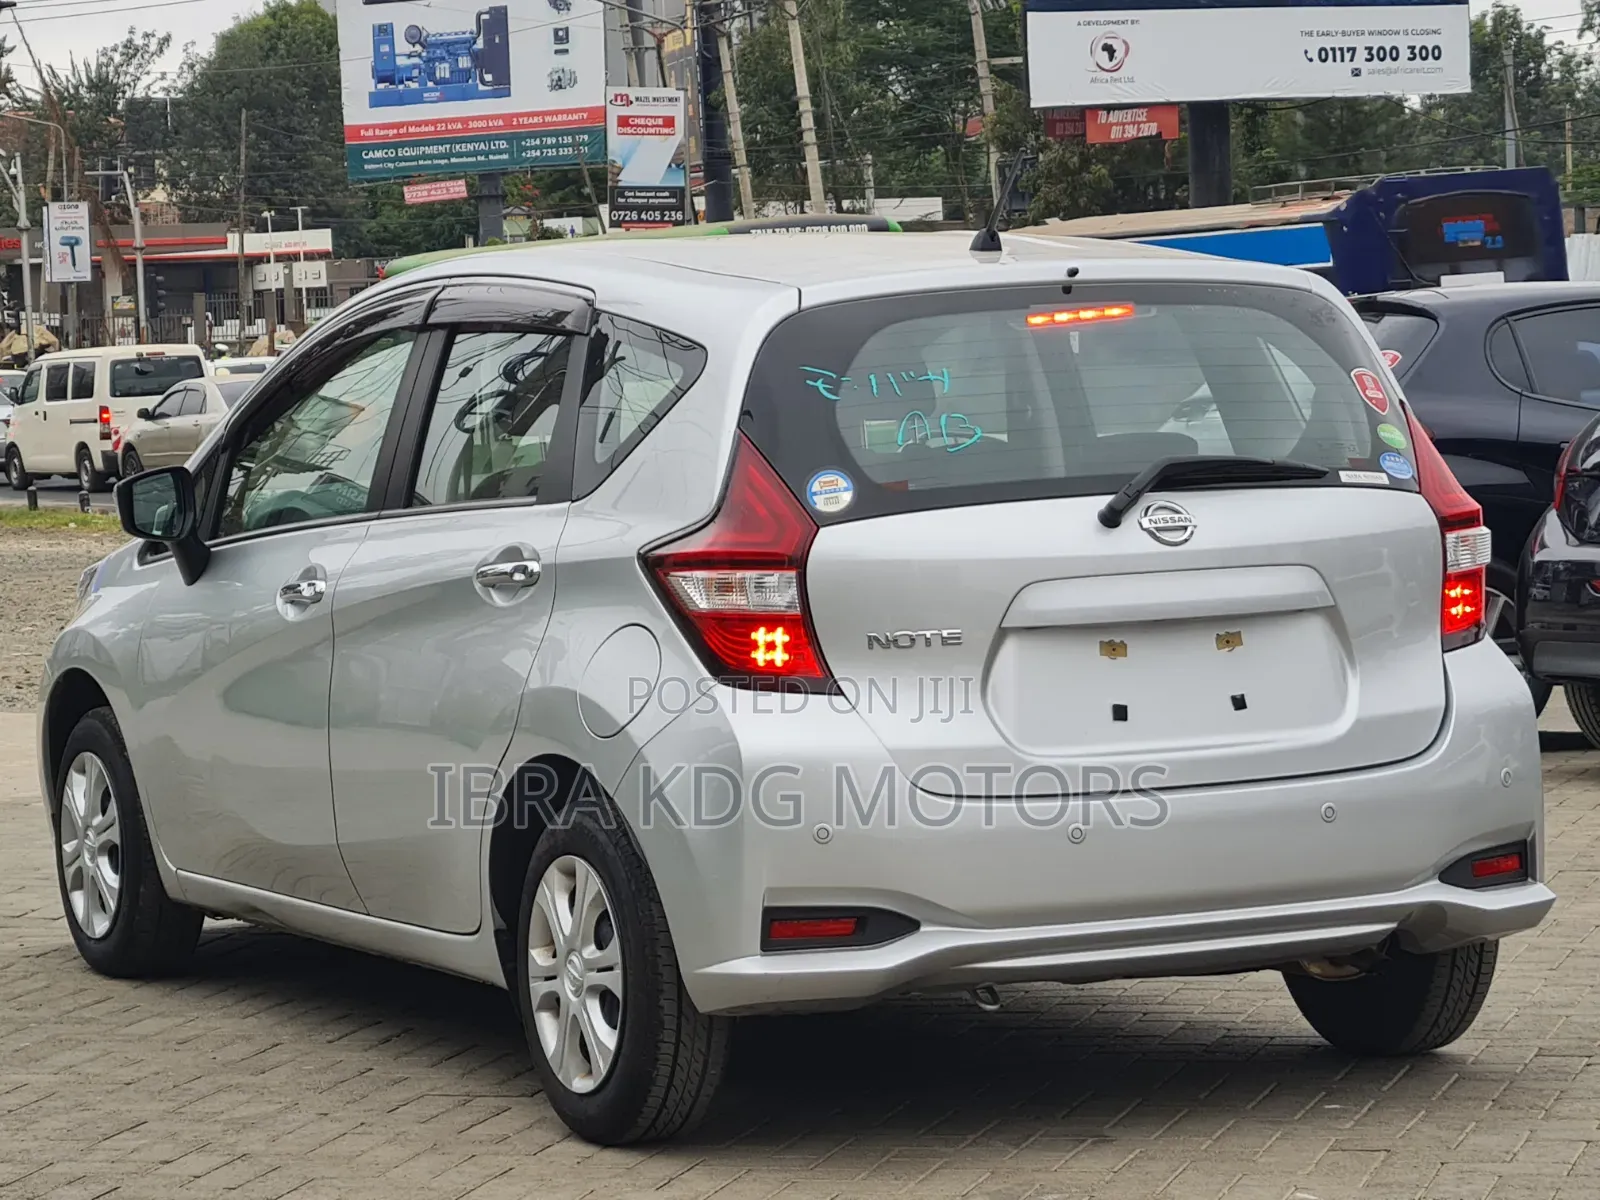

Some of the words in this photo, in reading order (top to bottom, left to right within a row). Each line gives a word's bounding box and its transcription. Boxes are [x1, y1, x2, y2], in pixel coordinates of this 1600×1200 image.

[1318, 46, 1357, 63] 0117
[1364, 46, 1400, 62] 300
[1406, 45, 1442, 62] 300
[628, 117, 664, 126] CHEQUE
[1097, 110, 1106, 124] TO
[1108, 108, 1148, 124] ADVERTISE
[360, 128, 374, 136] Full
[375, 128, 398, 137] Range
[408, 124, 435, 133] Models
[436, 123, 446, 131] 22
[448, 121, 462, 130] kVA
[468, 120, 487, 128] 3000
[488, 118, 504, 127] kVA
[519, 115, 543, 124] YEARS
[544, 112, 588, 123] WARRANTY
[618, 126, 676, 135] DISCOUNTING
[1110, 125, 1122, 139] 011
[1124, 124, 1138, 138] 394
[522, 136, 540, 146] +254
[542, 136, 556, 145] 789
[558, 136, 572, 144] 135
[362, 149, 396, 159] CAMCO
[398, 144, 452, 156] EQUIPMENT
[452, 140, 489, 152] (KENYA)
[490, 140, 509, 149] LTD.
[522, 148, 540, 158] +254
[542, 148, 556, 156] 735
[558, 147, 573, 156] 333
[610, 210, 638, 221] 0726
[640, 210, 661, 221] 405
[663, 210, 684, 221] 236
[1148, 516, 1192, 526] NISSAN
[866, 628, 963, 650] NOTE
